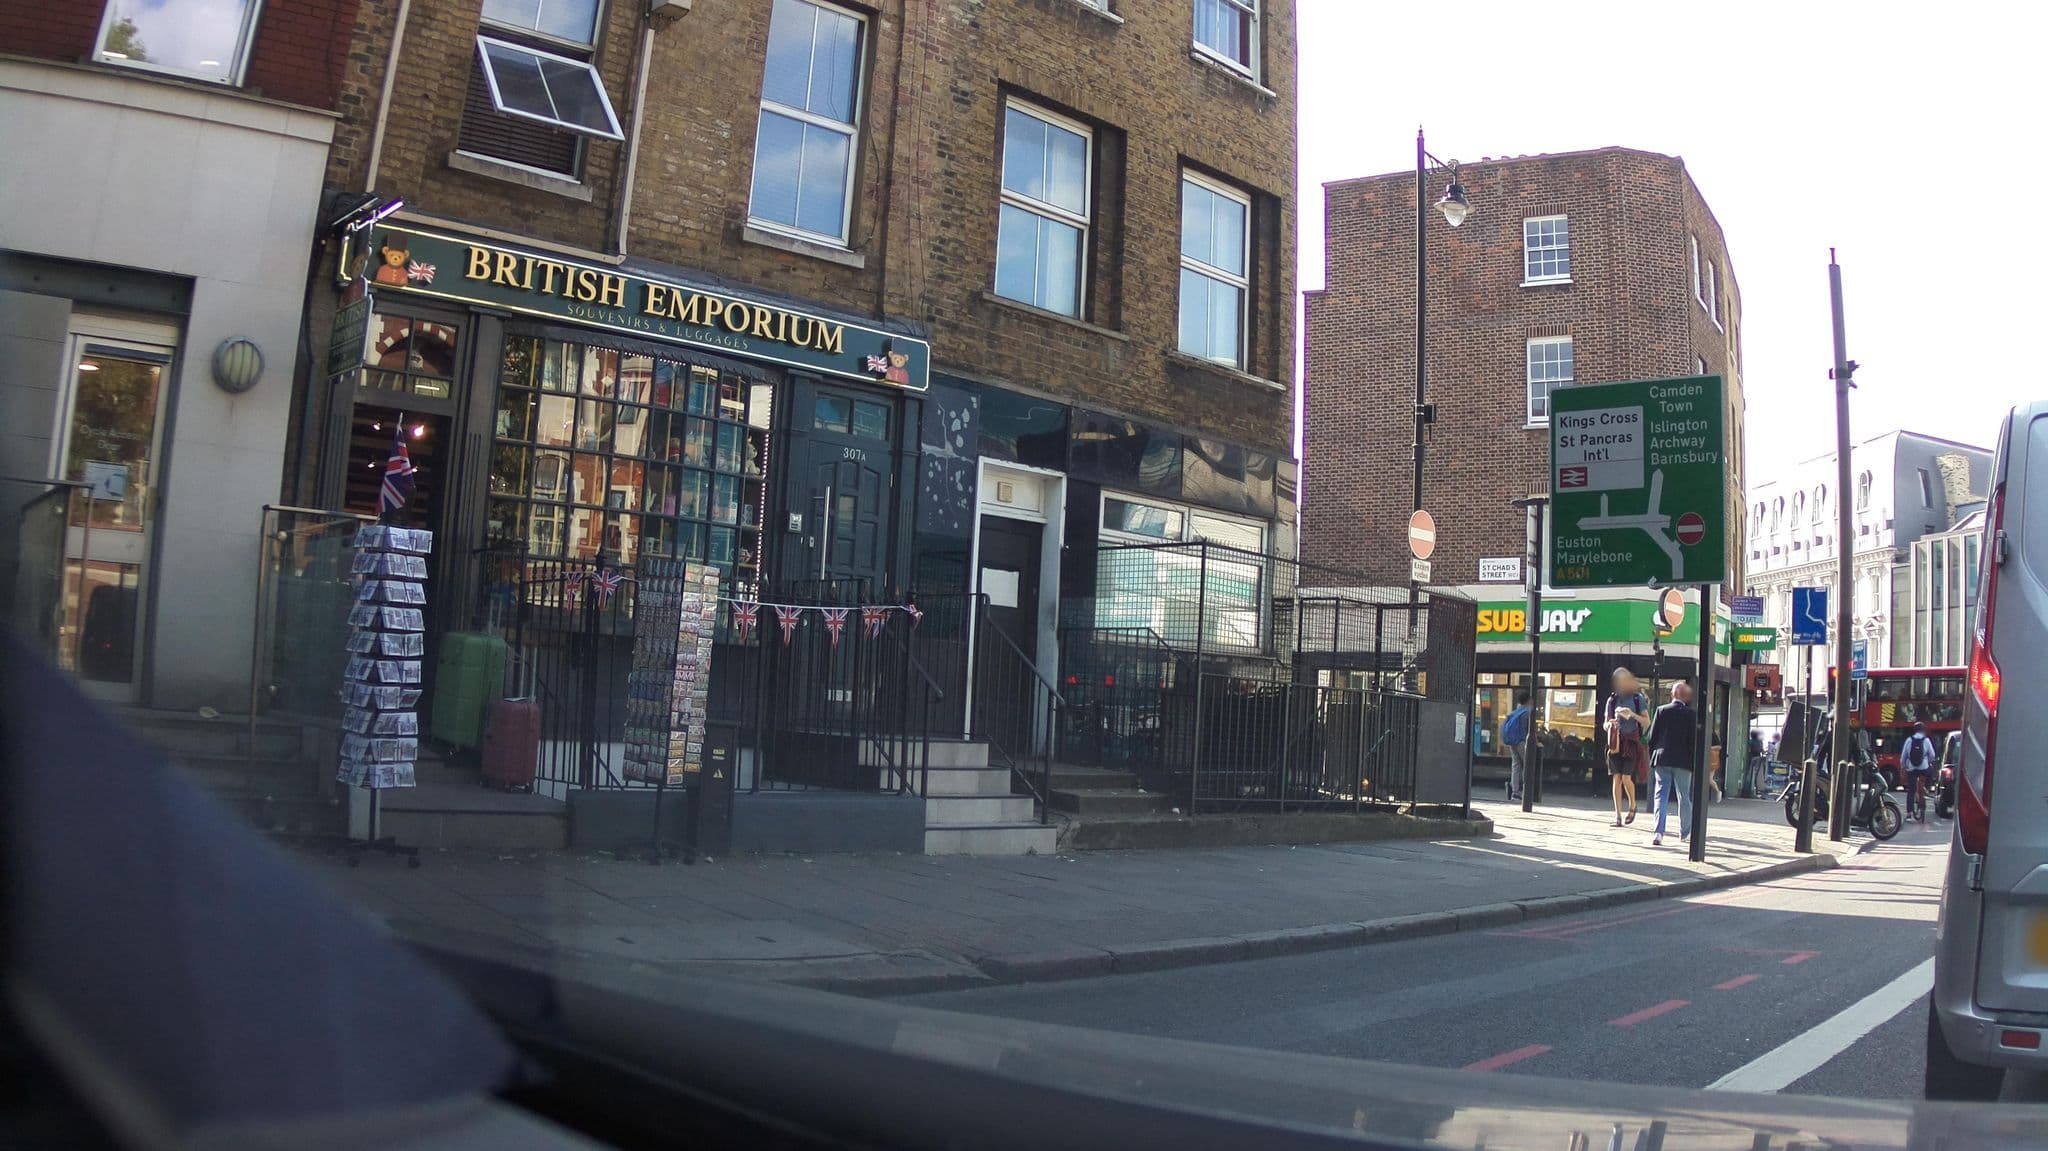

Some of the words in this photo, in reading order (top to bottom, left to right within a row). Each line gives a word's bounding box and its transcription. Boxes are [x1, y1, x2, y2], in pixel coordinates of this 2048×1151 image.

[466, 246, 628, 308] BRITISH
[644, 283, 845, 354] EMPORIUM
[568, 304, 650, 330] SOUVENIRS
[659, 323, 666, 333] &
[676, 326, 748, 350] LUGGAGES
[1649, 384, 1703, 398] Camden
[1659, 401, 1693, 413] Town
[1560, 416, 1595, 429] Kings
[1600, 413, 1638, 425] Cross
[1650, 419, 1708, 434] Islington
[1560, 435, 1575, 448] St
[1580, 433, 1632, 446] Pancras
[1650, 435, 1705, 449] Archway
[1584, 448, 1609, 461] Int'l
[1651, 450, 1718, 465] Barnsbury
[1557, 536, 1601, 549] Euston
[1557, 550, 1632, 566] Marylebone
[1738, 634, 1773, 643] SUBWAY
